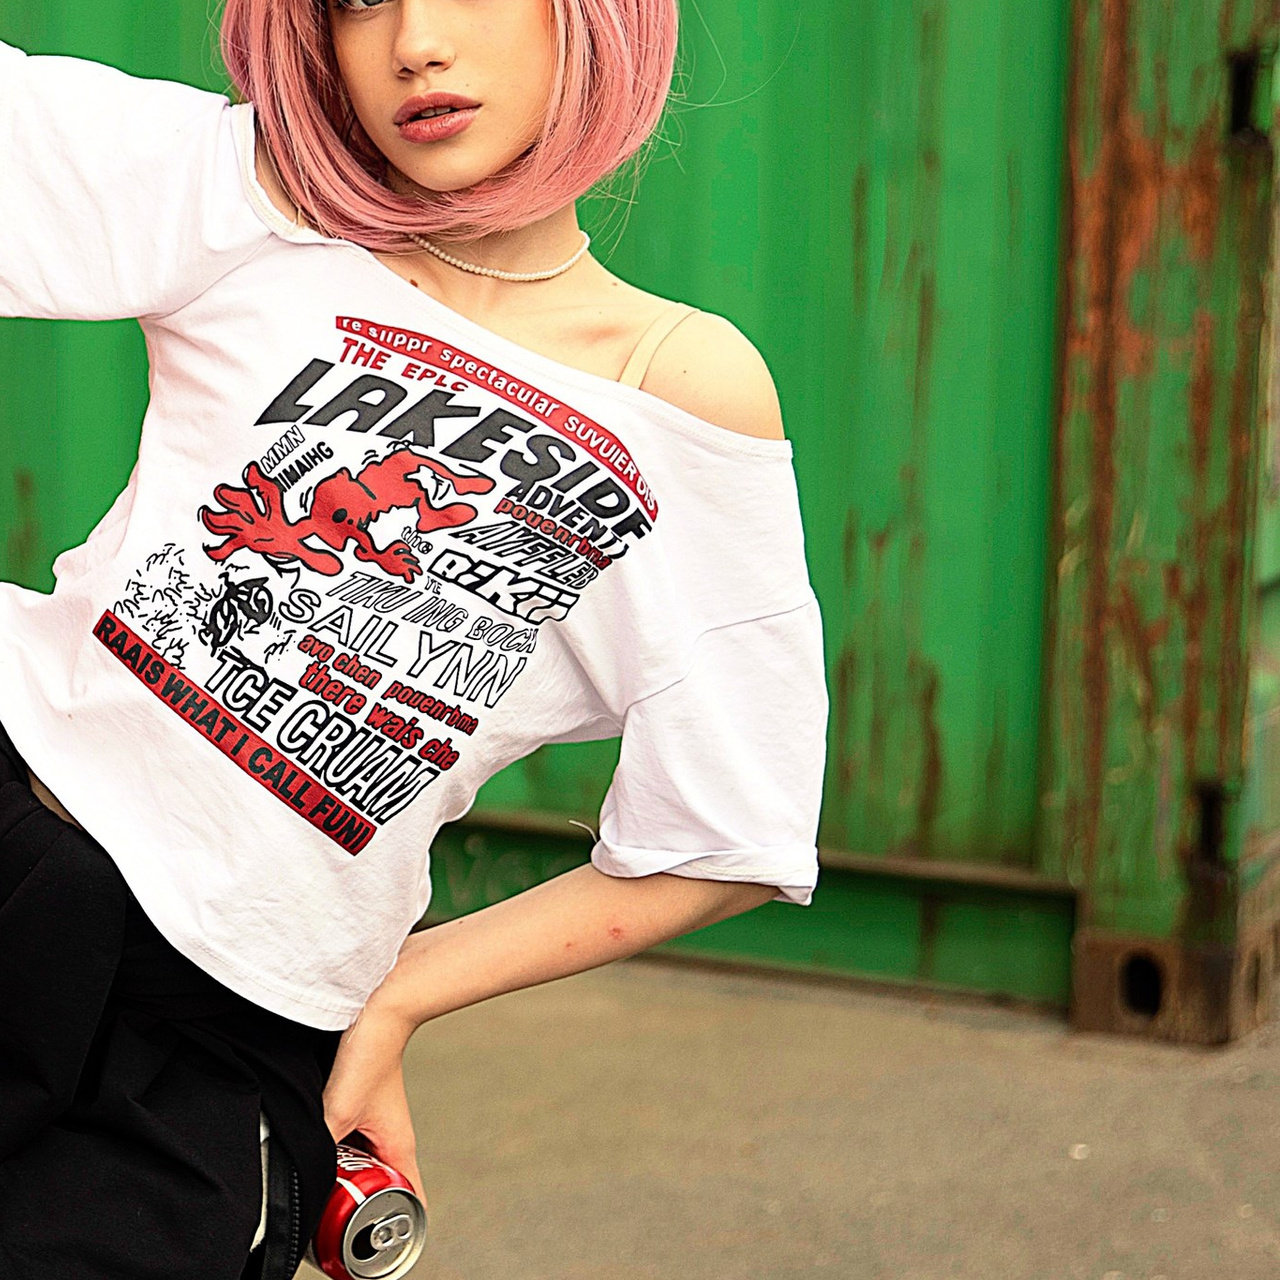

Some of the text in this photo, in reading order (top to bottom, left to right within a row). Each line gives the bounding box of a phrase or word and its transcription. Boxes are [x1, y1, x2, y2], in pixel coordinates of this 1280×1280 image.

[340, 337, 392, 371] THE
[439, 348, 561, 418] spectacular
[278, 588, 399, 667] SAIL
[297, 662, 368, 716] there
[160, 671, 239, 746] WHAT
[247, 749, 312, 809] CALL
